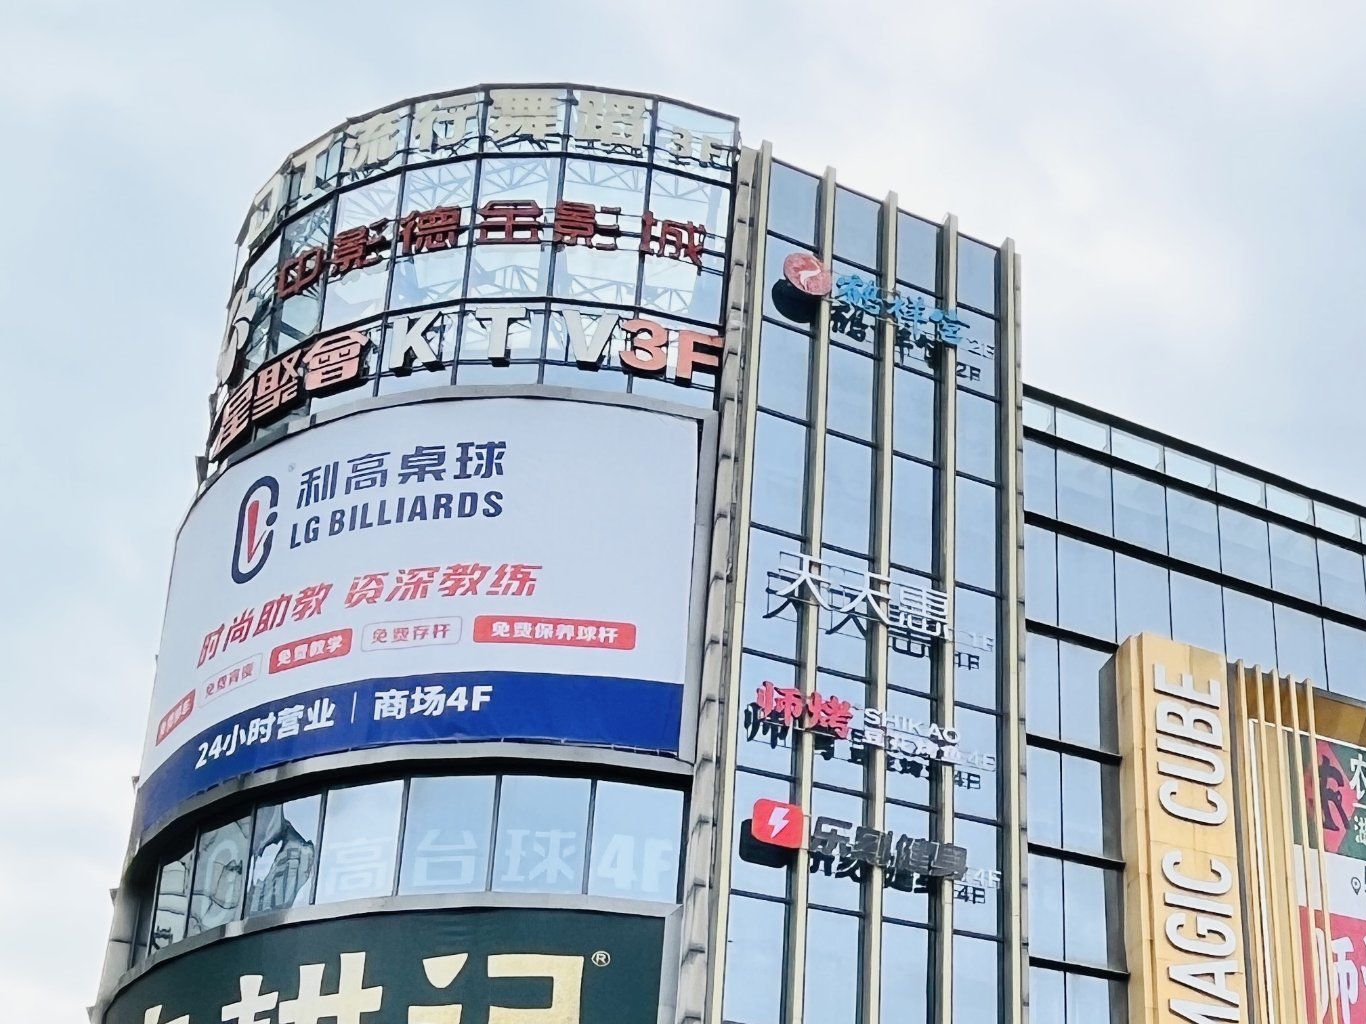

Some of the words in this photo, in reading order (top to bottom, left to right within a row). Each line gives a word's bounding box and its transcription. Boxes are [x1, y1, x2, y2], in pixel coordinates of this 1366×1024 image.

[392, 305, 622, 369] KTV
[620, 318, 727, 382] 3F
[296, 441, 507, 508] 利高桌球
[290, 516, 319, 549] LG
[329, 490, 504, 537] BILLIARDS
[197, 581, 333, 669] 时尚助教
[344, 562, 543, 609] 资深教练
[491, 621, 619, 644] 免费保养球杆
[194, 697, 336, 770] 24小时营业
[373, 684, 493, 721] 商场4F
[756, 680, 852, 740] 师烤
[1153, 663, 1230, 826] CUBE
